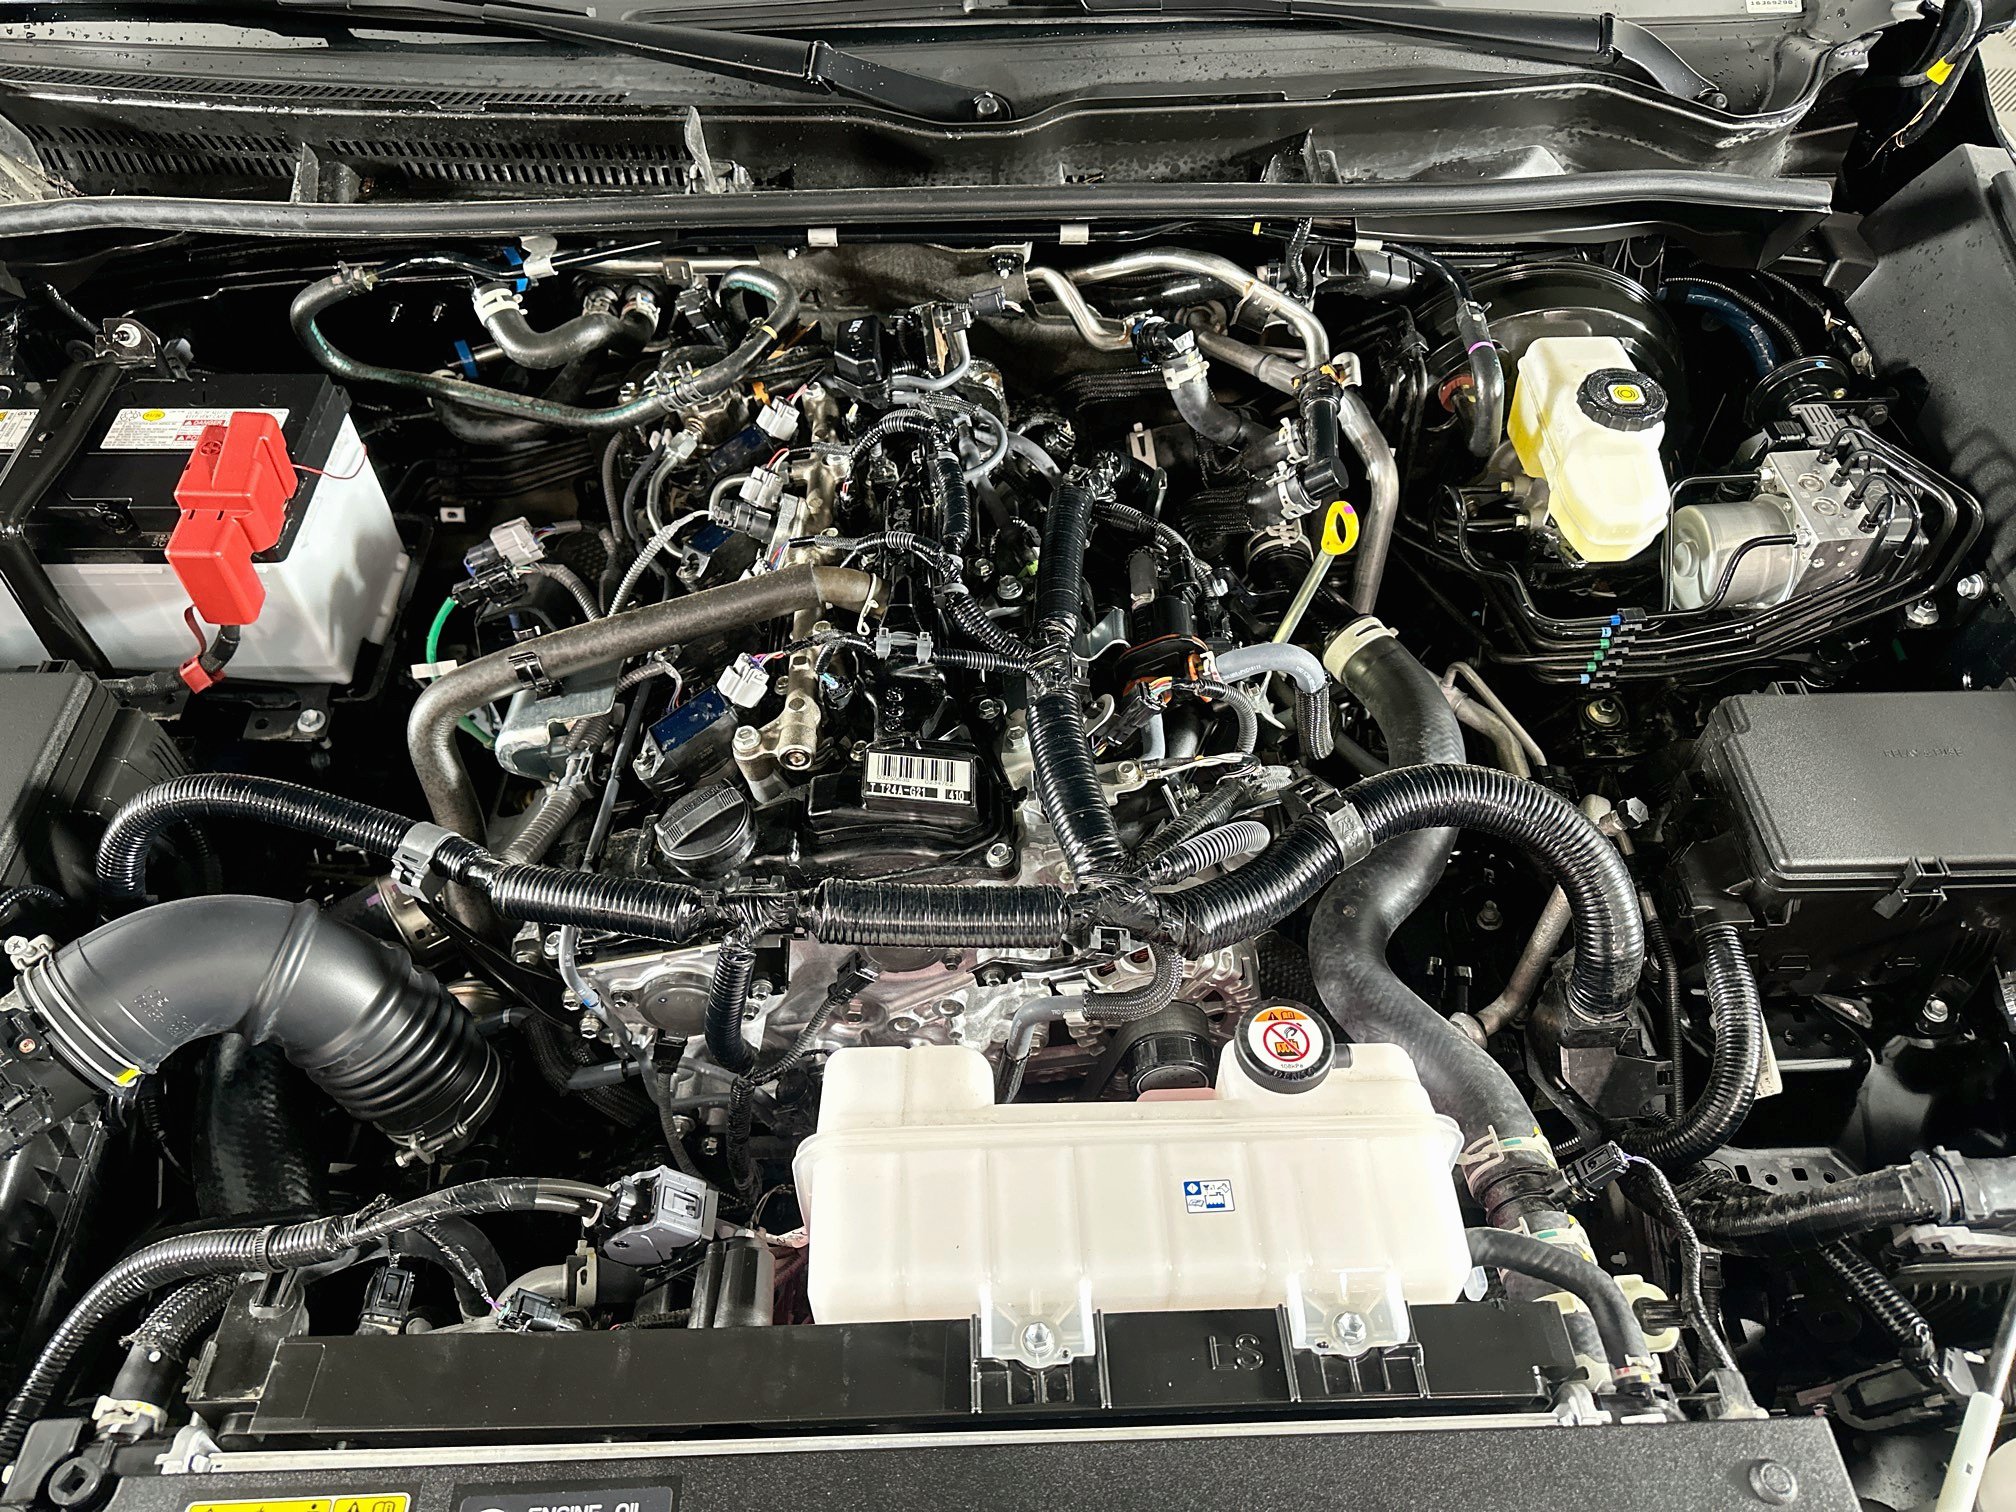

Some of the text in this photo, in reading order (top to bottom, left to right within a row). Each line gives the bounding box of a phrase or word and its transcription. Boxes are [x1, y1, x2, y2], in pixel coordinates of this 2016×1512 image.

[881, 783, 926, 798] T24A-G21
[948, 791, 965, 801] 410
[1208, 1333, 1264, 1370] LS
